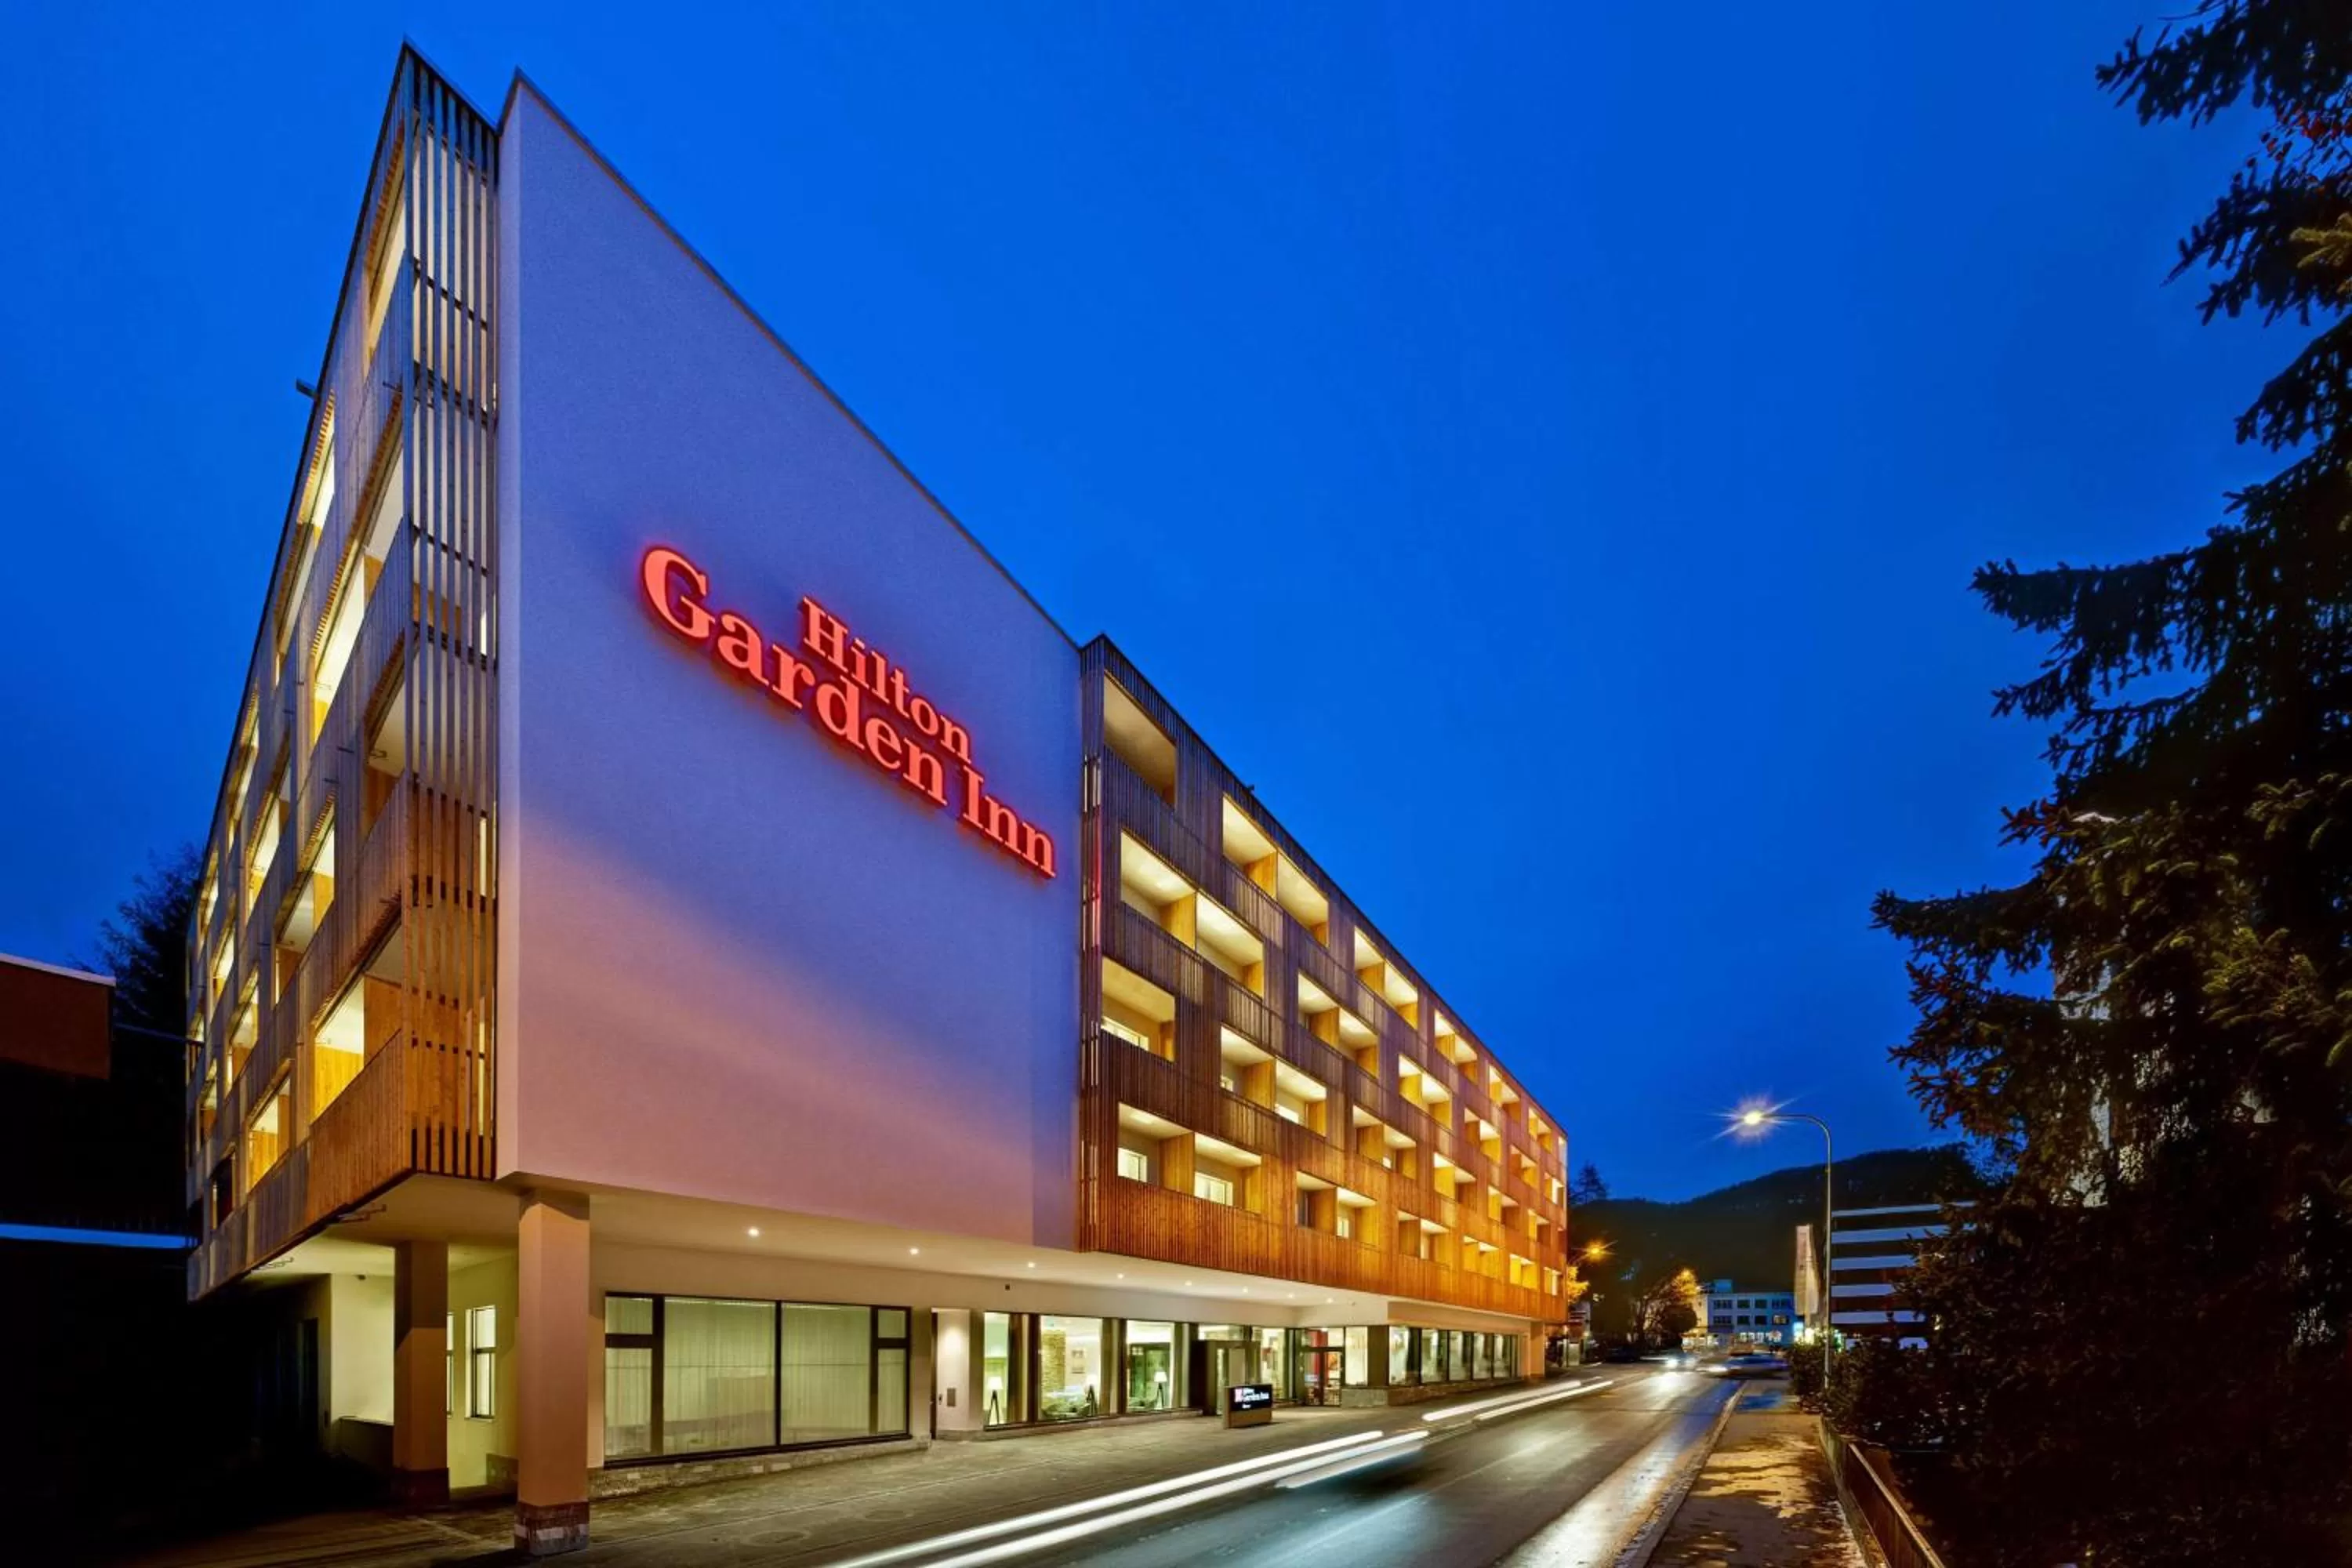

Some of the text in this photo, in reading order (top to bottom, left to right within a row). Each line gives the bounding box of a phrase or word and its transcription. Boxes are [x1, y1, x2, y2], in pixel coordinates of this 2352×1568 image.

[643, 548, 1056, 879] Garden Inn
[801, 597, 971, 764] Hilton
